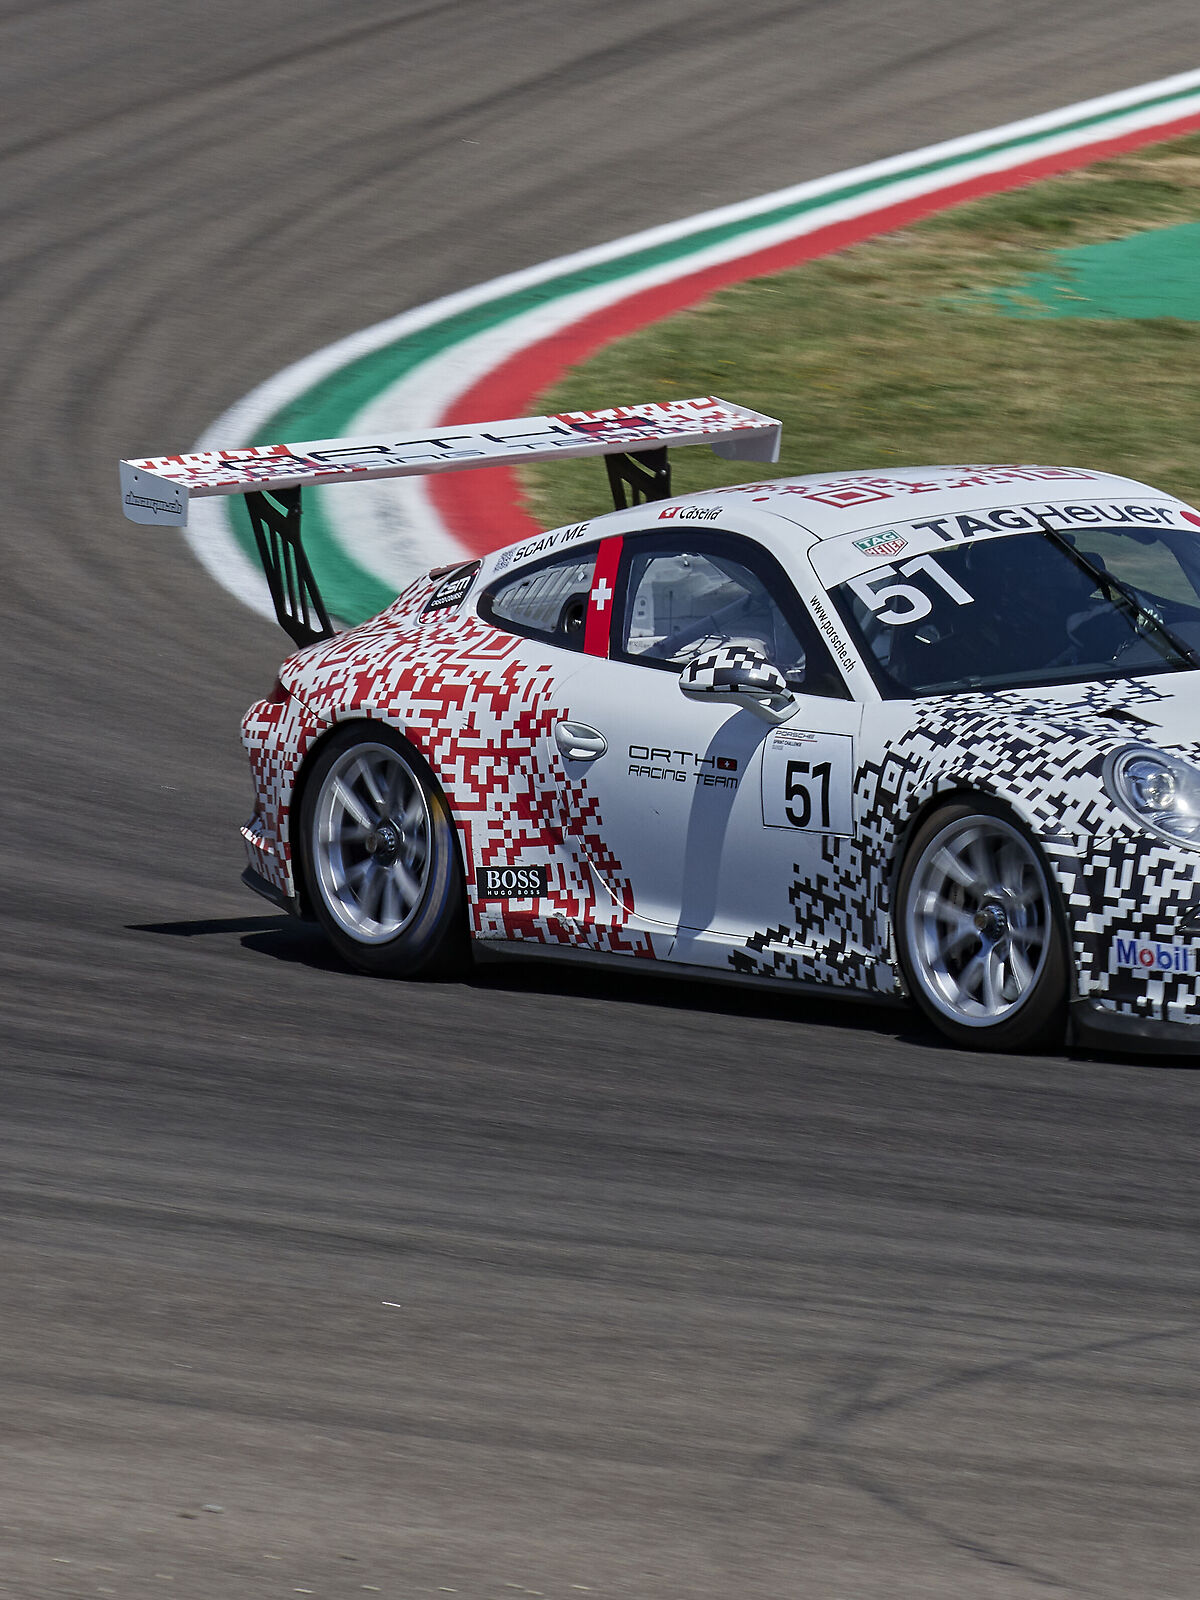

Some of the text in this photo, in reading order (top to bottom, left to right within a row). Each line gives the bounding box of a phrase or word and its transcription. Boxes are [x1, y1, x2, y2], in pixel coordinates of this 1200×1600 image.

[513, 522, 590, 563] SCAN ME
[858, 531, 897, 548] TAG
[846, 554, 975, 625] 51
[809, 595, 857, 673] www.porsche.ch
[775, 730, 816, 739] PORSCHE
[628, 764, 739, 789] RACING TEAM
[785, 760, 832, 827] 51
[486, 870, 541, 889] BOSS
[1117, 939, 1189, 971] Mobil
